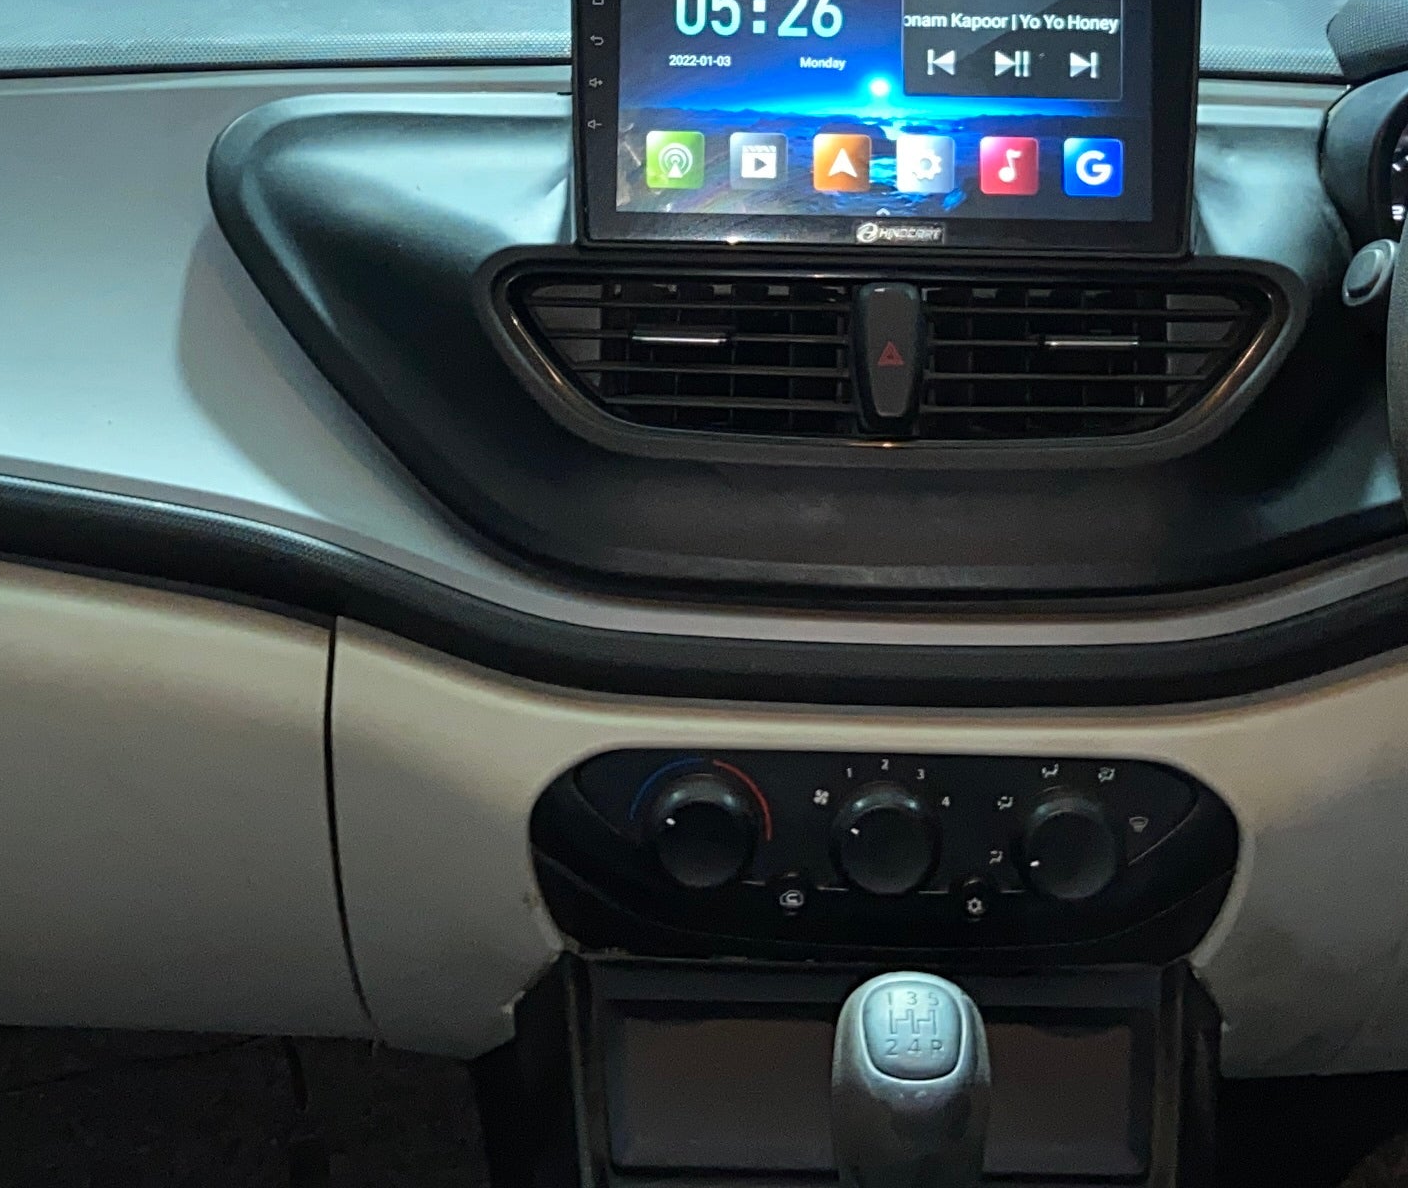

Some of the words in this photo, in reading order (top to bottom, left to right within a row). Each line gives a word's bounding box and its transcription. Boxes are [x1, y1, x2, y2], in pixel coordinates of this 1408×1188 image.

[951, 13, 1008, 31] Kapoor
[1019, 14, 1041, 30] Yo
[1043, 14, 1065, 30] Yo
[1067, 15, 1119, 35] Honey
[669, 54, 732, 67] 2022-01-03
[799, 56, 847, 71] Monday
[880, 758, 890, 771] 2
[846, 767, 853, 779] 1
[916, 768, 925, 780] 3
[941, 796, 951, 807] 4
[887, 991, 893, 1006] 1
[906, 991, 918, 1006] 3
[928, 991, 939, 1006] 5
[885, 1038, 899, 1056] 2
[907, 1038, 921, 1054] 4
